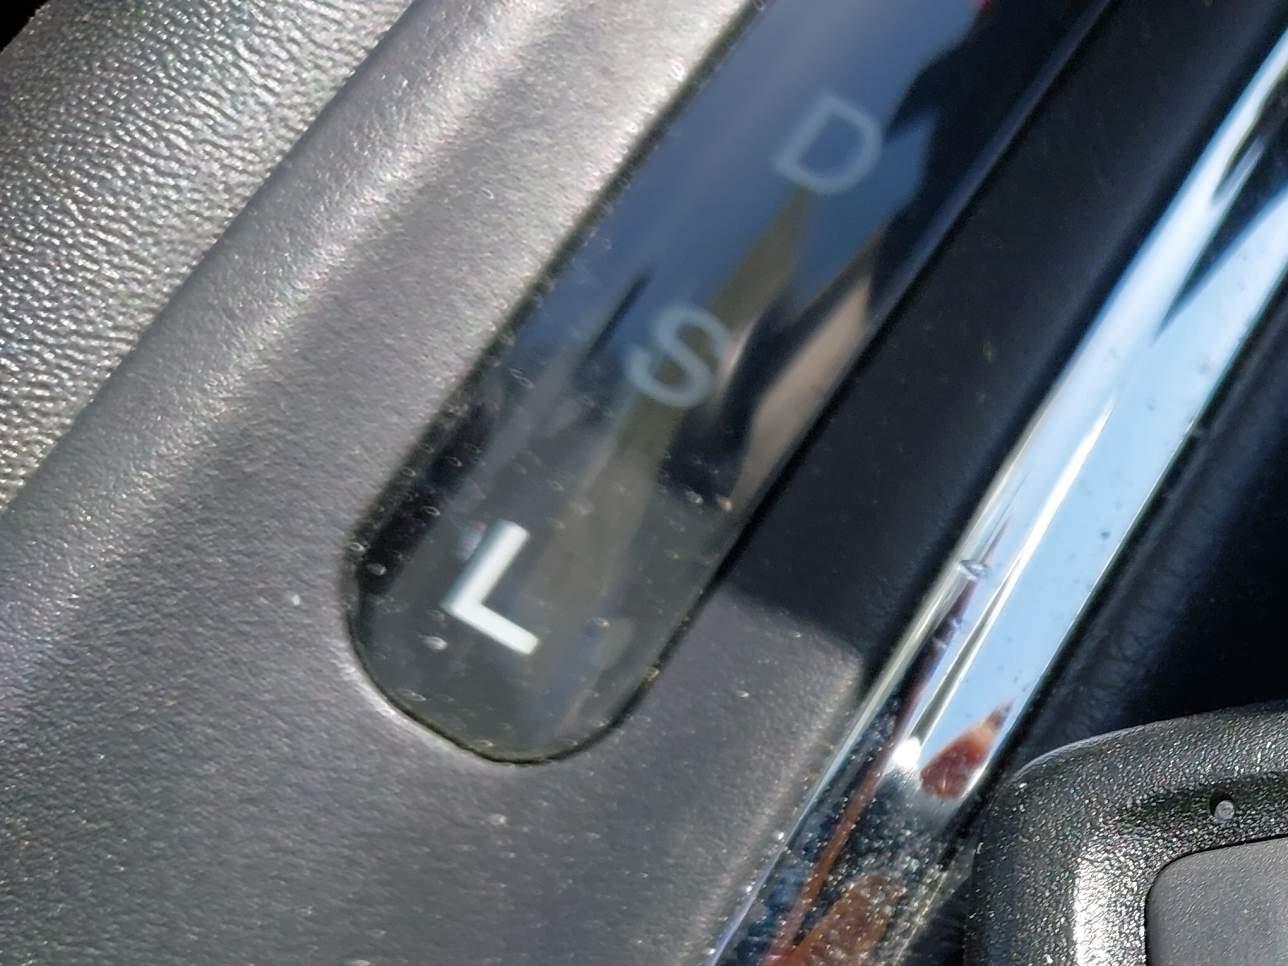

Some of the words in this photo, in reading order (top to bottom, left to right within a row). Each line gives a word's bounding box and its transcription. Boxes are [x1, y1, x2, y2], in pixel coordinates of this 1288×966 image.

[774, 92, 884, 195] D
[624, 303, 734, 409] S
[443, 519, 540, 656] L
